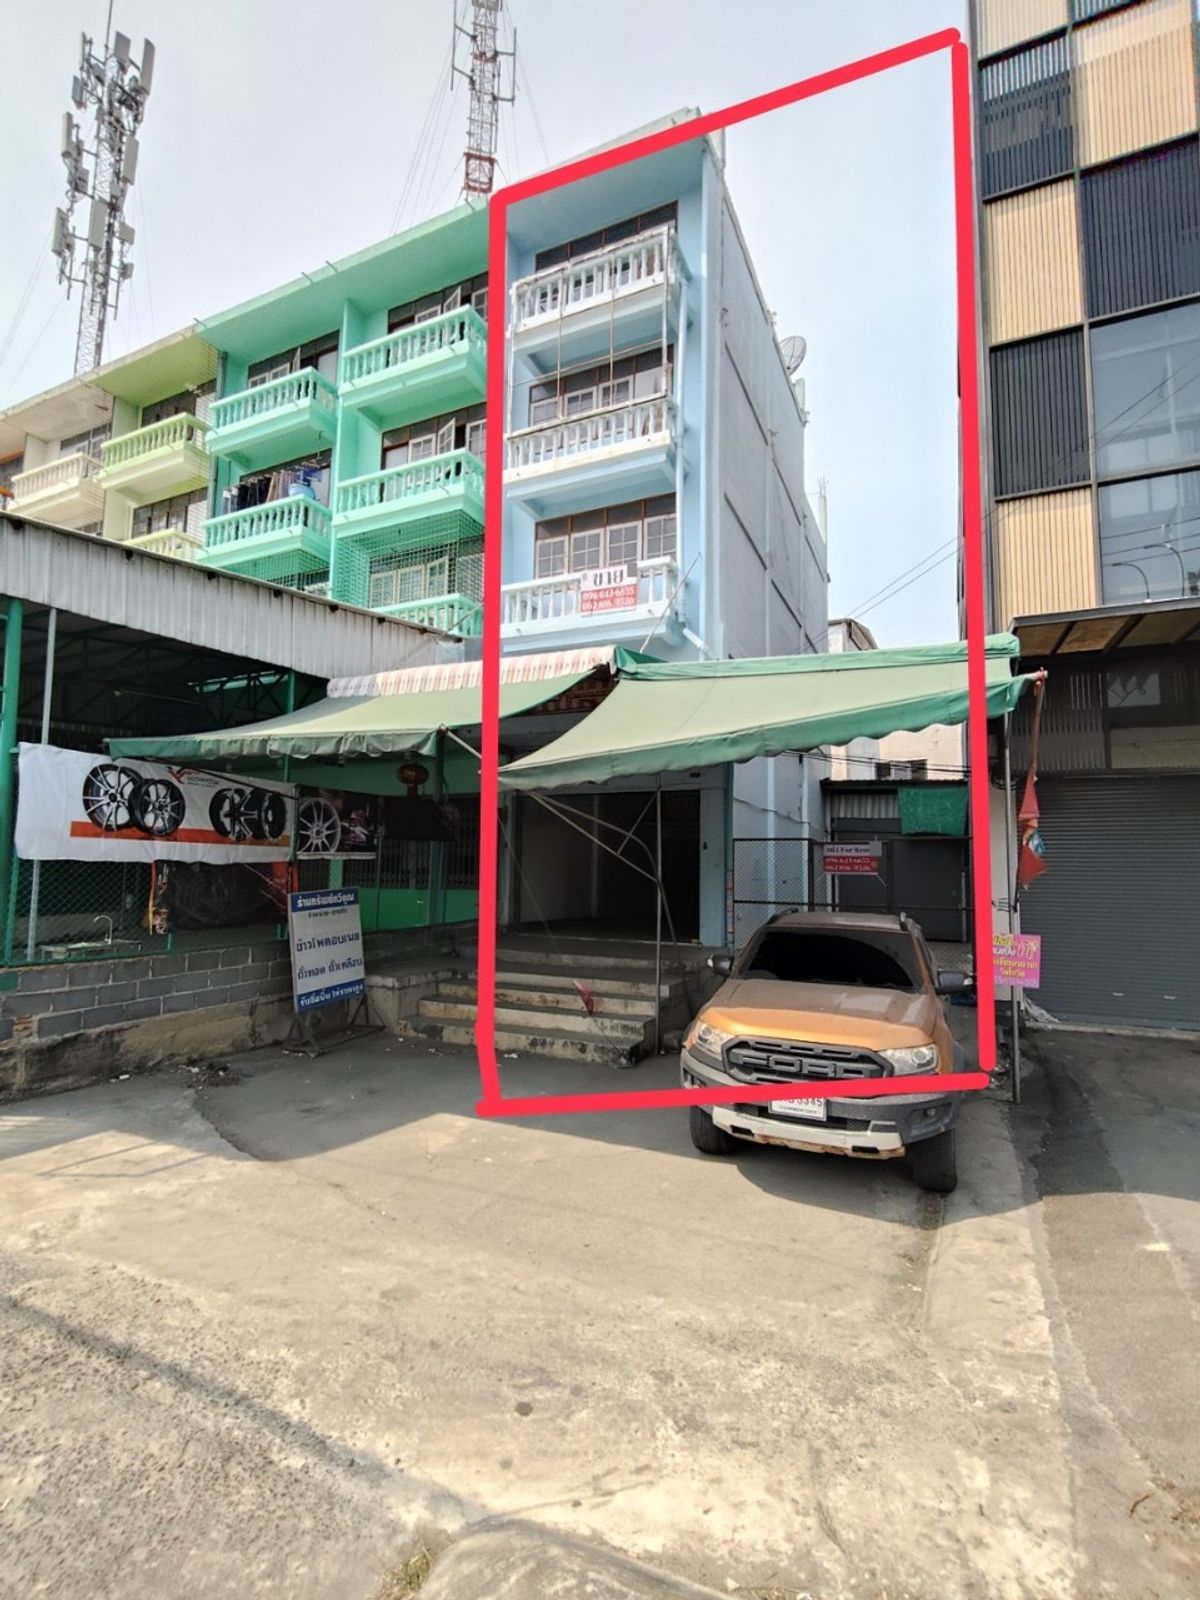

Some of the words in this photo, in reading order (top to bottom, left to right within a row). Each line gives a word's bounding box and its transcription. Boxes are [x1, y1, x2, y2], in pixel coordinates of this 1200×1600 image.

[593, 569, 624, 587] ขาย
[296, 932, 360, 952] ข้าวโพดอบเนย
[730, 1049, 868, 1078] FORD
